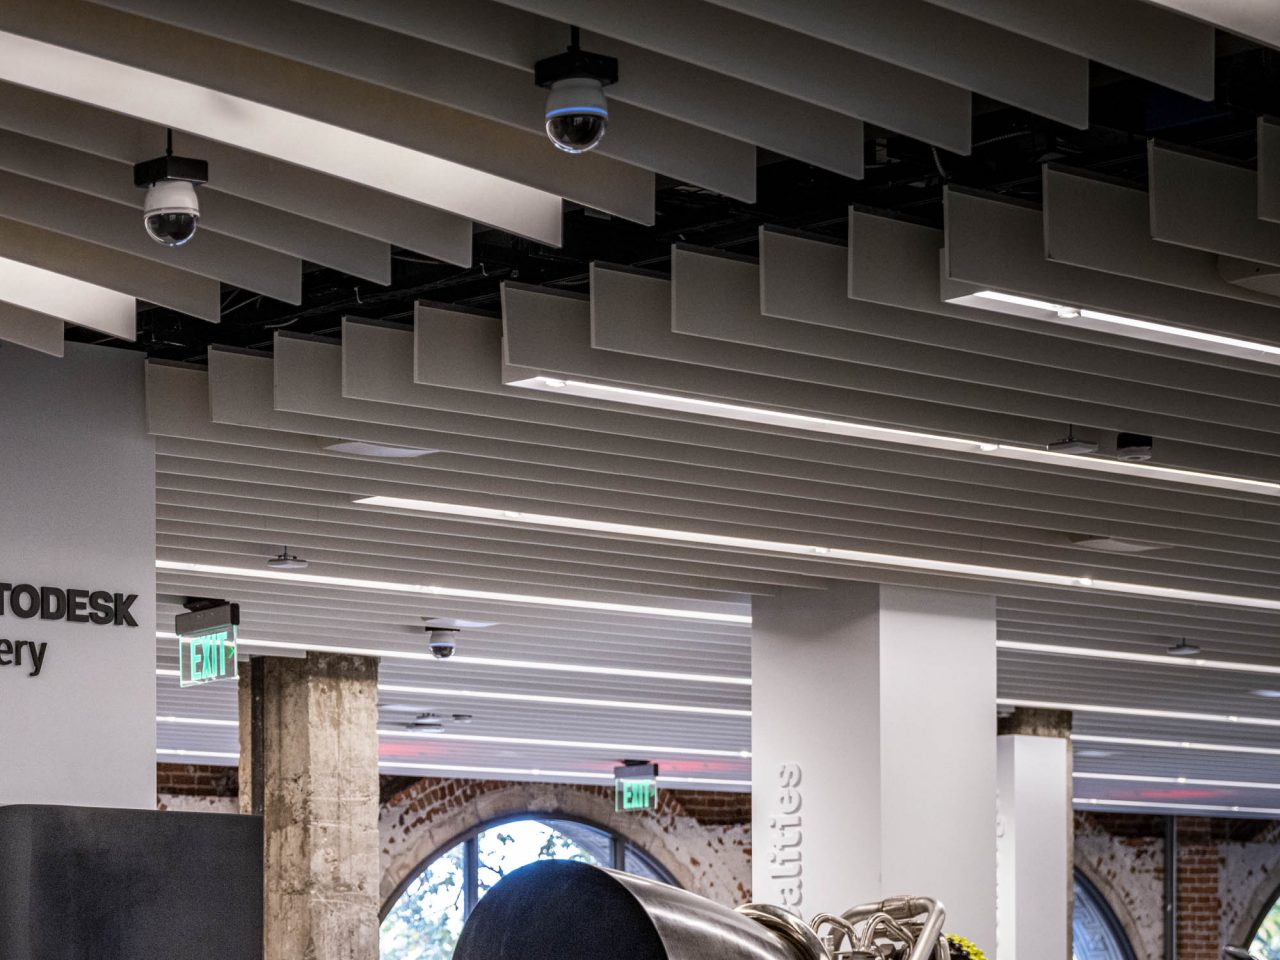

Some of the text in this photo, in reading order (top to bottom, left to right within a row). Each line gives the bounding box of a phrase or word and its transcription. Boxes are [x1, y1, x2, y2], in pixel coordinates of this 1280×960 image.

[190, 631, 228, 681] EXIT
[623, 780, 650, 810] EXIT
[770, 762, 803, 919] alities
